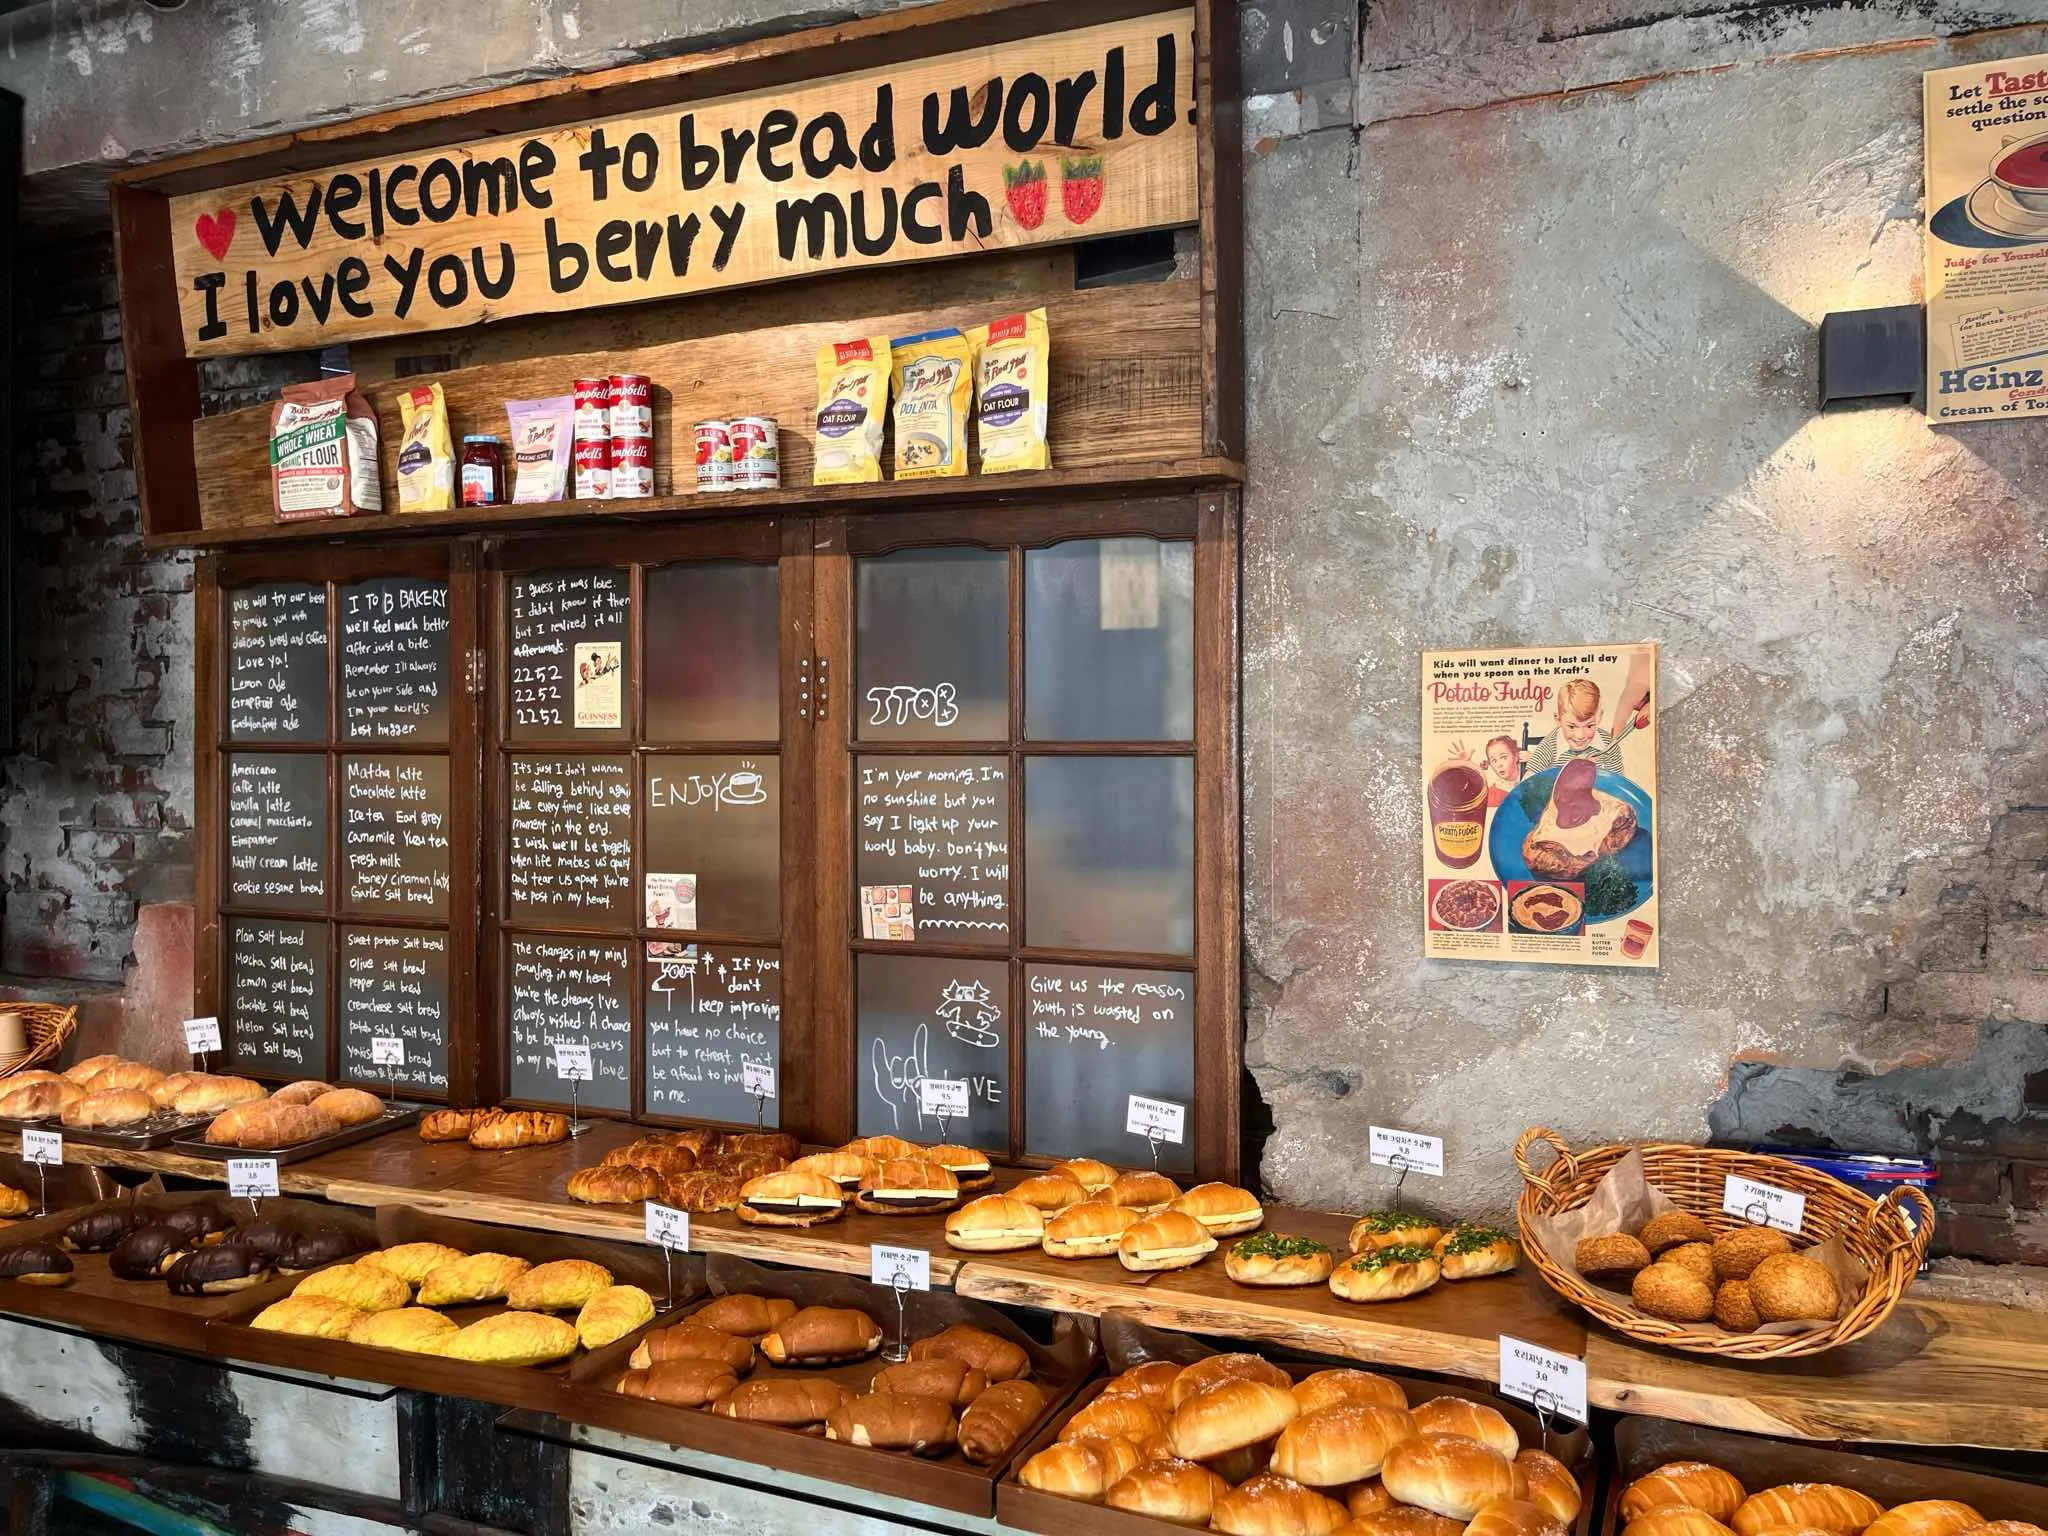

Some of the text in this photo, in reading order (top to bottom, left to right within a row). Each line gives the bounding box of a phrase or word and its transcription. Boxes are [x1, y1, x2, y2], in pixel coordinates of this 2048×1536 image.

[1949, 86, 1982, 100] Let
[1946, 97, 2026, 118] settle the
[579, 129, 659, 201] to
[678, 83, 896, 190] bread
[194, 163, 992, 341] I love you berry much
[1944, 258, 1977, 269] Judge
[1982, 255, 1999, 265] for
[1939, 368, 2043, 394] Heinz
[983, 397, 1019, 412] OAT FLOUR
[1940, 405, 1994, 417] Cream
[2001, 401, 2019, 411] of
[823, 414, 857, 424] OAT FLOUR
[277, 424, 336, 457] WHOLE WHEAT
[302, 444, 338, 466] FLOUR
[515, 587, 524, 599] I
[529, 582, 553, 597] guess
[558, 580, 566, 593] it
[571, 580, 588, 589] was
[233, 599, 249, 612] We
[252, 595, 267, 608] will
[272, 592, 286, 608] try
[290, 593, 305, 602] our
[348, 589, 447, 615] I To B BAKERY
[515, 608, 524, 618] I
[561, 596, 586, 611] know
[593, 596, 602, 609] it
[607, 593, 631, 606] then
[516, 612, 622, 639] but I realized it all
[1433, 654, 1618, 669] Kids will want dinner to last all day
[514, 665, 562, 683] 2252
[1433, 665, 1590, 680] when you spoon on the Kraft's
[515, 686, 561, 702] 2252
[1427, 679, 1553, 712] Potato Fudge
[517, 709, 562, 725] 2252
[578, 712, 618, 720] GUINNESS
[232, 763, 277, 777] Americano
[348, 763, 423, 783] Matcha latte
[512, 762, 531, 775] It's
[535, 763, 551, 775] just
[556, 763, 563, 775] I
[592, 764, 624, 774] wanna
[895, 769, 922, 789] your
[350, 784, 427, 801] Chocolate latte
[652, 772, 726, 812] ENJOY
[864, 790, 995, 808] no sunshine but you
[349, 808, 442, 829] Ice tea Earl grey
[864, 815, 999, 835] say I light up your
[347, 831, 395, 845] Camomile
[428, 834, 448, 847] tea
[350, 853, 401, 870] Fresh milk
[971, 865, 980, 880] I
[985, 863, 1008, 880] will
[919, 888, 936, 906] be
[235, 928, 255, 944] Plain
[280, 928, 304, 946] bread
[731, 958, 779, 973] If you
[1030, 975, 1185, 1000] Give us the reason
[699, 998, 724, 1017] keep
[1032, 999, 1174, 1024] Youth is wasted on
[650, 1020, 767, 1044] you have no choice
[1035, 1022, 1061, 1038] the
[652, 1043, 672, 1057] but
[676, 1045, 688, 1058] to
[599, 1059, 628, 1080] love
[653, 1066, 720, 1082] be afraid to
[653, 1086, 664, 1102] in
[1514, 1349, 1543, 1365] 오리지널
